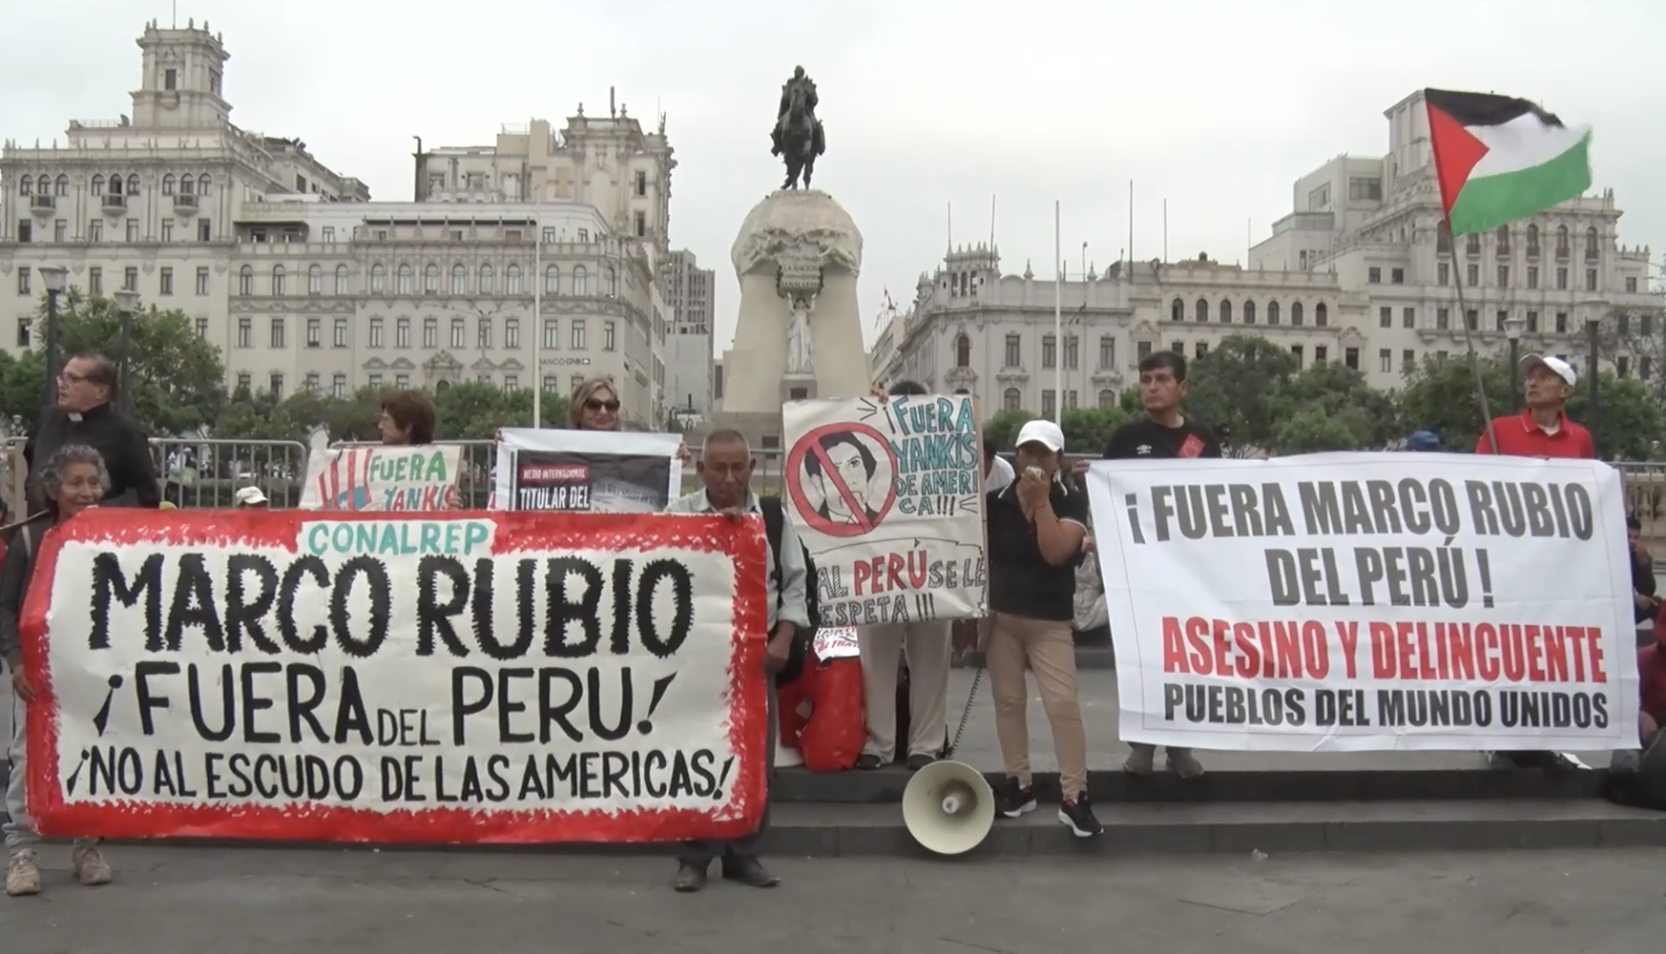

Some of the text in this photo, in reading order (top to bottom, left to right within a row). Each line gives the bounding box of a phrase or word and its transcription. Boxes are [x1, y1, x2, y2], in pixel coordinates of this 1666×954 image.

[369, 451, 447, 481] FUERA
[523, 468, 586, 480] MEDIO INTERNACIONAL
[889, 432, 979, 474] YANKIS
[520, 487, 567, 510] TITULAR
[569, 485, 590, 509] DEL
[894, 470, 979, 497] DE AMERI
[1297, 477, 1460, 535] MARCO
[1464, 480, 1594, 541] RUBIO
[308, 522, 489, 556] CONALREP
[816, 565, 849, 600] AL
[928, 560, 958, 589] SE
[1264, 547, 1350, 606] DEL
[88, 552, 695, 660] MARCO RUBIO
[819, 594, 909, 627] ESPETA
[1162, 616, 1607, 683] ASESINO Y DELINCUENTE
[92, 661, 678, 746] ¡FUERA DEL PERU!
[1164, 683, 1609, 729] PUEBLOS DEL MUNDO UNIDOS
[66, 745, 735, 802] ¡NO AL ESCUDO DE LAS AMERICAS!
